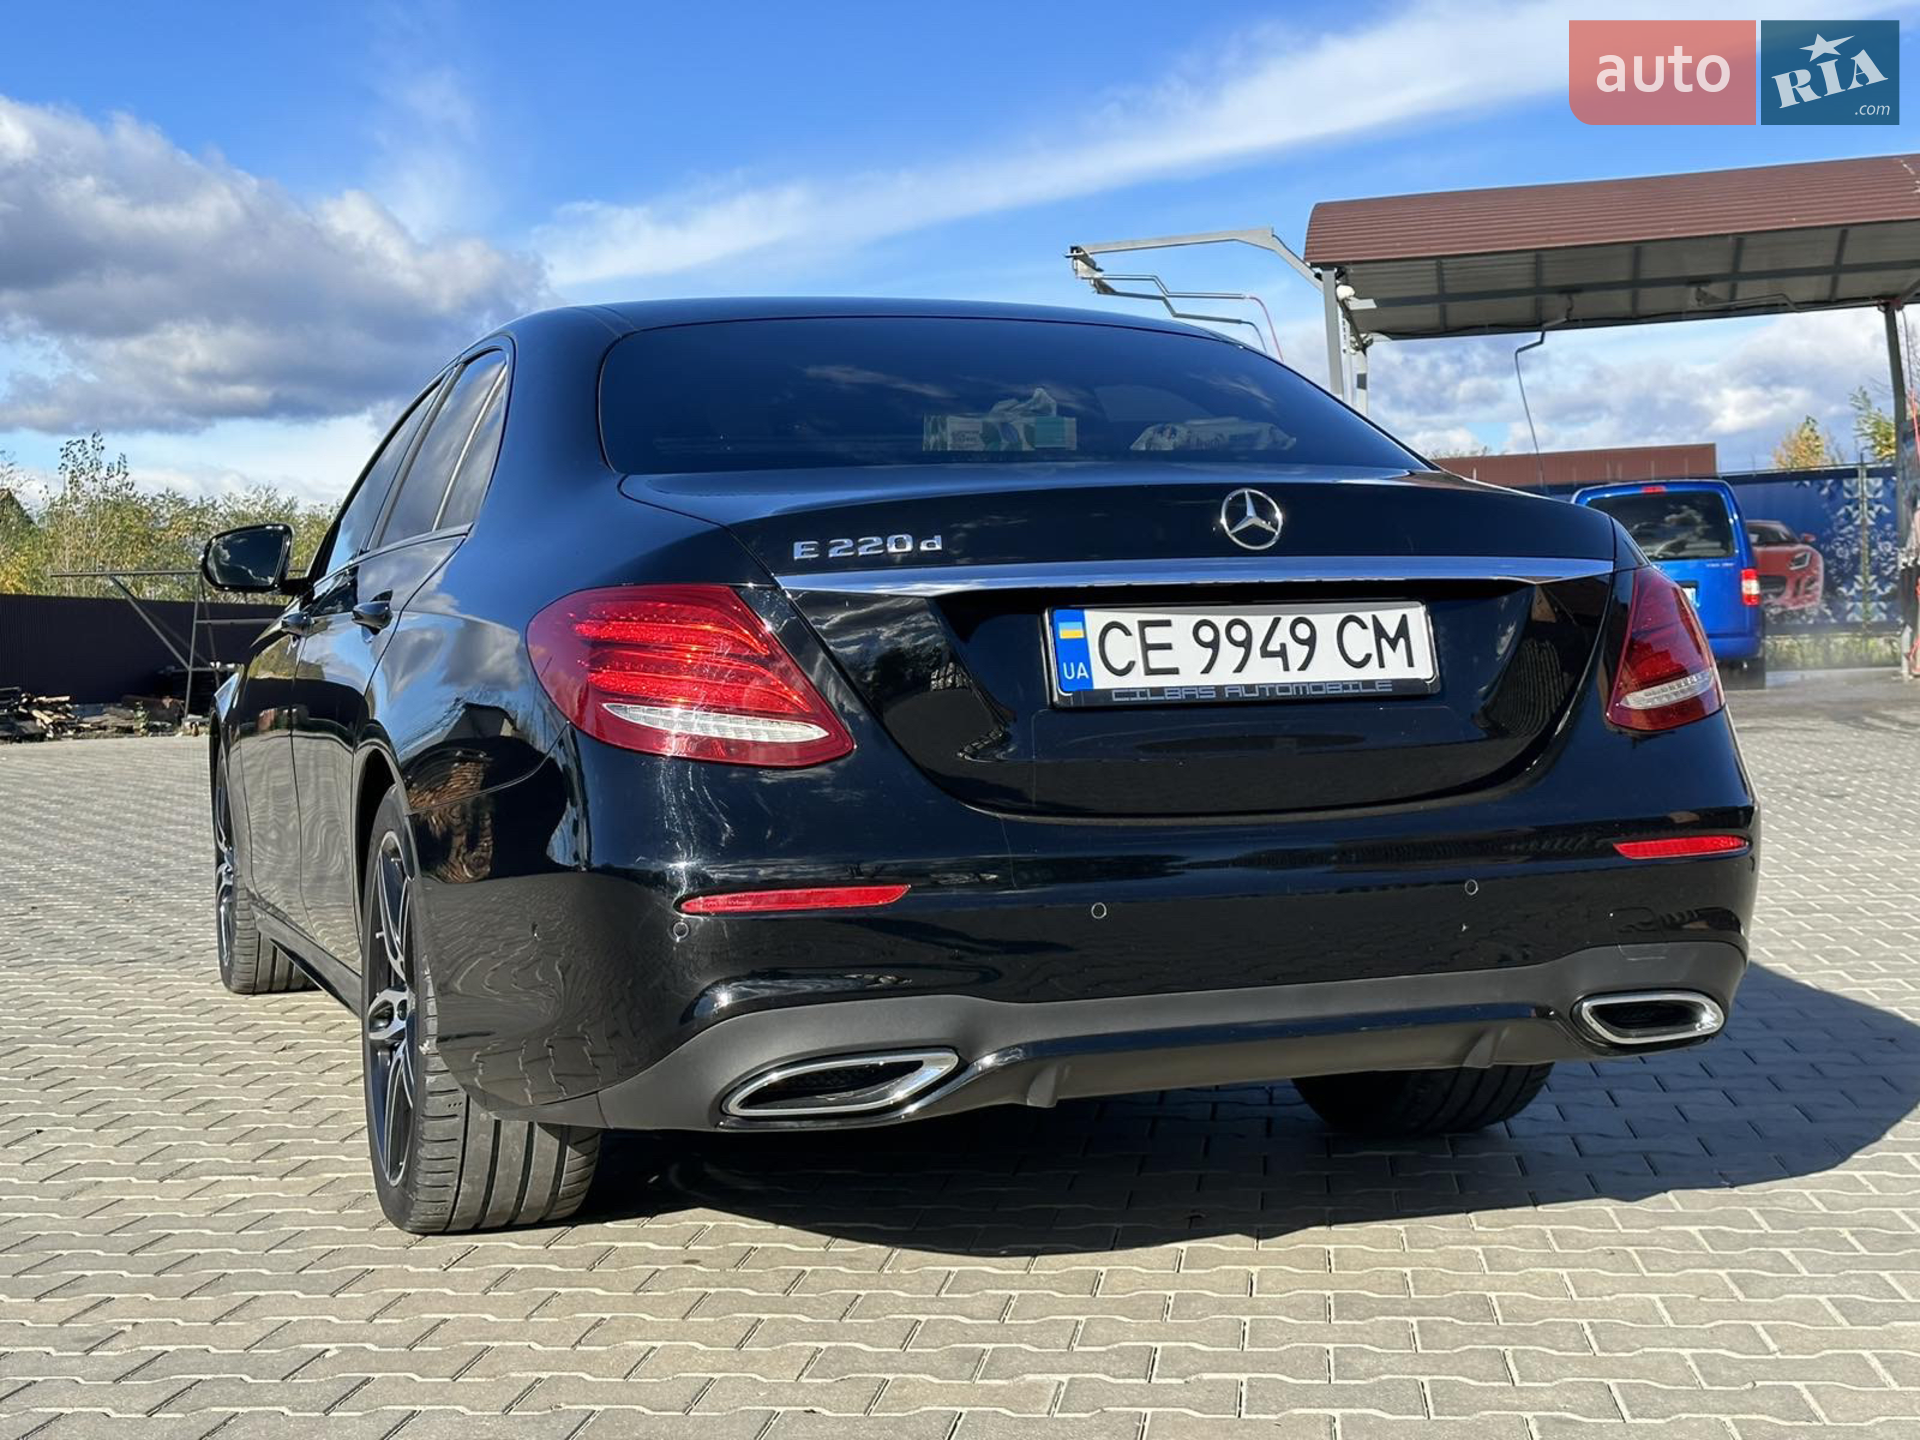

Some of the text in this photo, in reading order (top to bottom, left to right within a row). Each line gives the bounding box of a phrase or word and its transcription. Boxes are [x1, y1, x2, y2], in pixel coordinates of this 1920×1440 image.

[1098, 613, 1415, 677] CE 9949 CM
[1063, 661, 1090, 680] UA
[1111, 679, 1393, 702] CILBAS AUTOMOBILE
